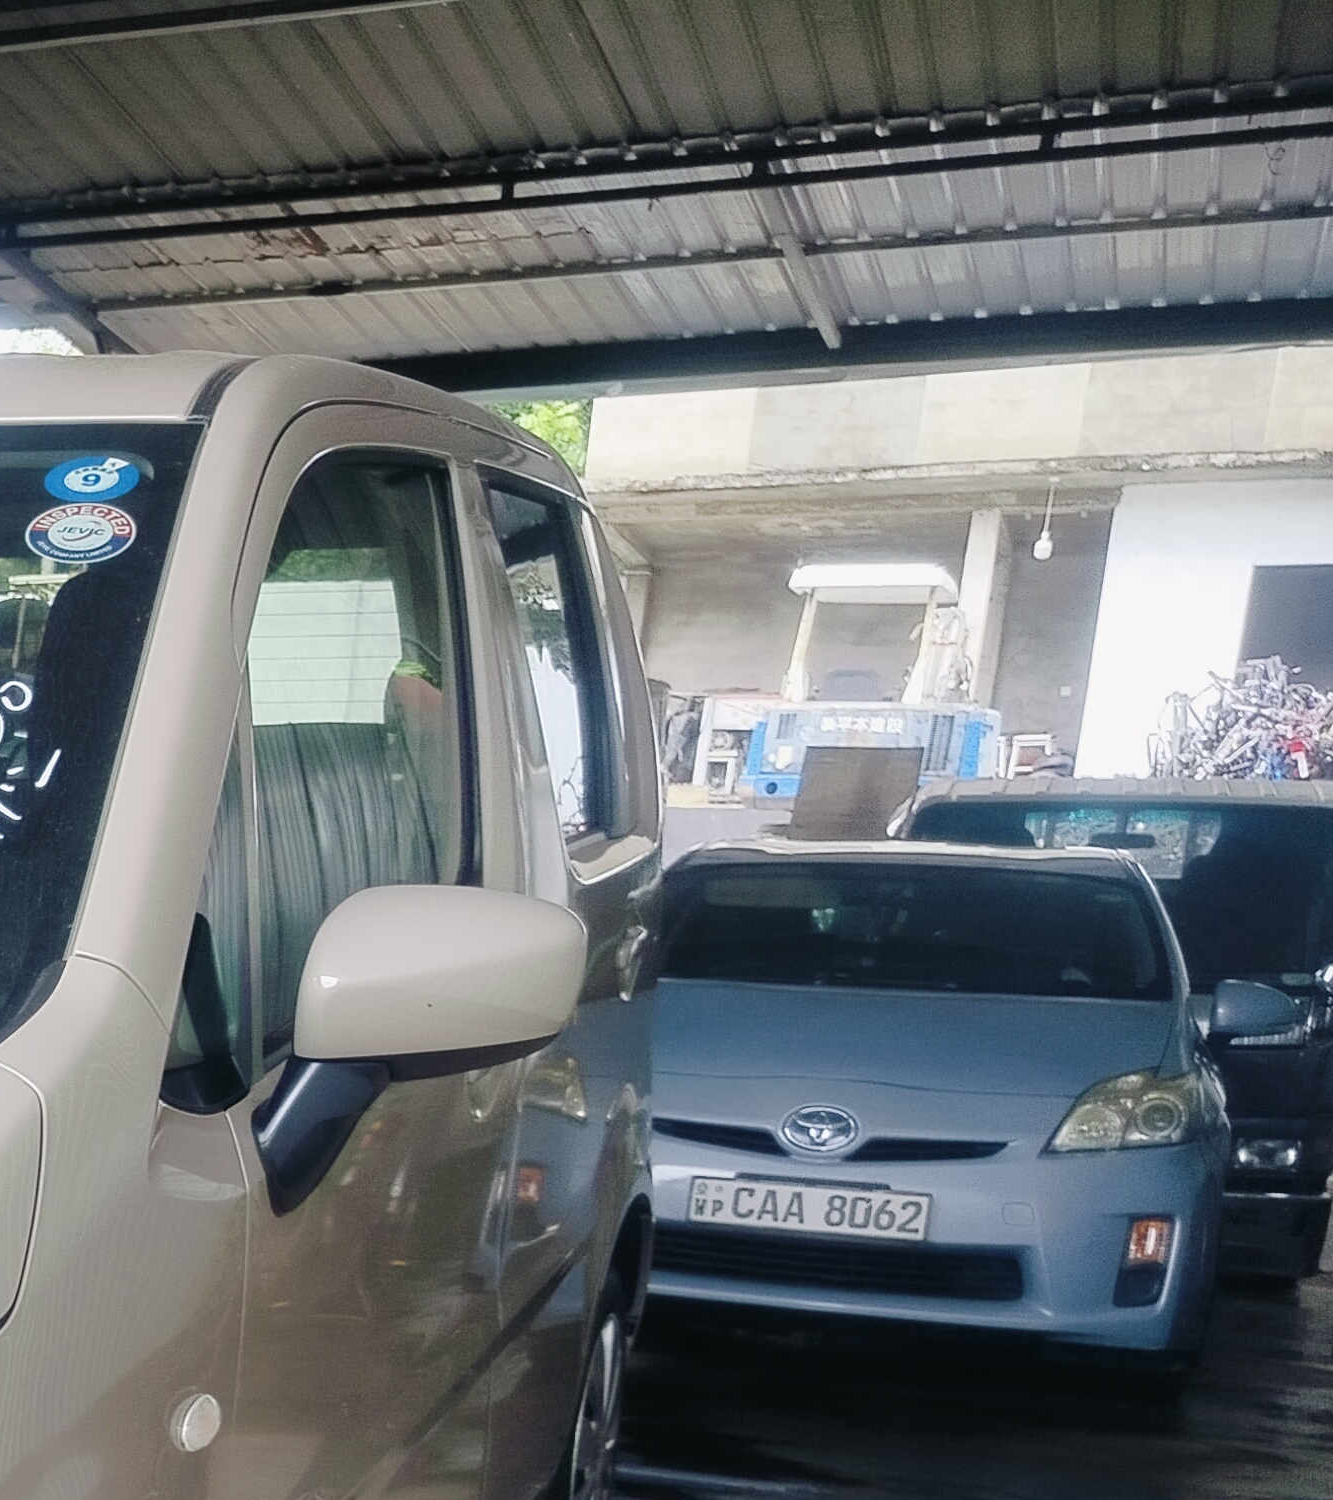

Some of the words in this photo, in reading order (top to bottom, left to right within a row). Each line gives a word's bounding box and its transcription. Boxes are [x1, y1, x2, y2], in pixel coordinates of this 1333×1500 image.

[35, 506, 131, 535] INSPECTED
[57, 526, 106, 536] JEVIC
[733, 1187, 805, 1224] CAA
[824, 1195, 923, 1233] 8062
